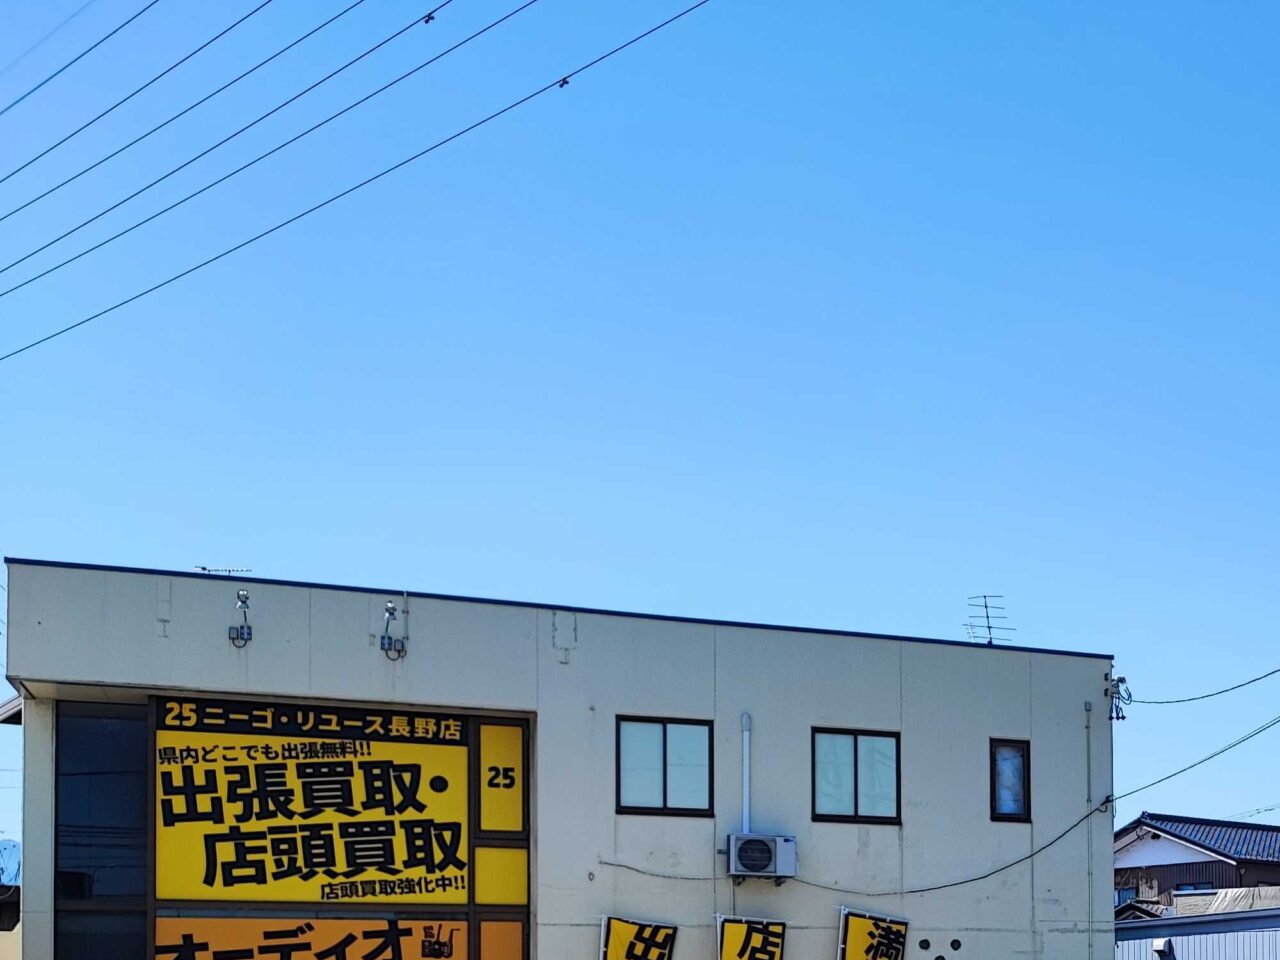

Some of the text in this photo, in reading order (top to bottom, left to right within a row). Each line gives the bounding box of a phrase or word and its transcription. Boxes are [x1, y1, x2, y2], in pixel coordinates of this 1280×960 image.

[165, 702, 462, 740] 25 ニーゴ・リユース長野店
[487, 766, 515, 789] 25
[203, 819, 467, 887] 店頭買取
[321, 875, 466, 900] 店頭買取強化中!!
